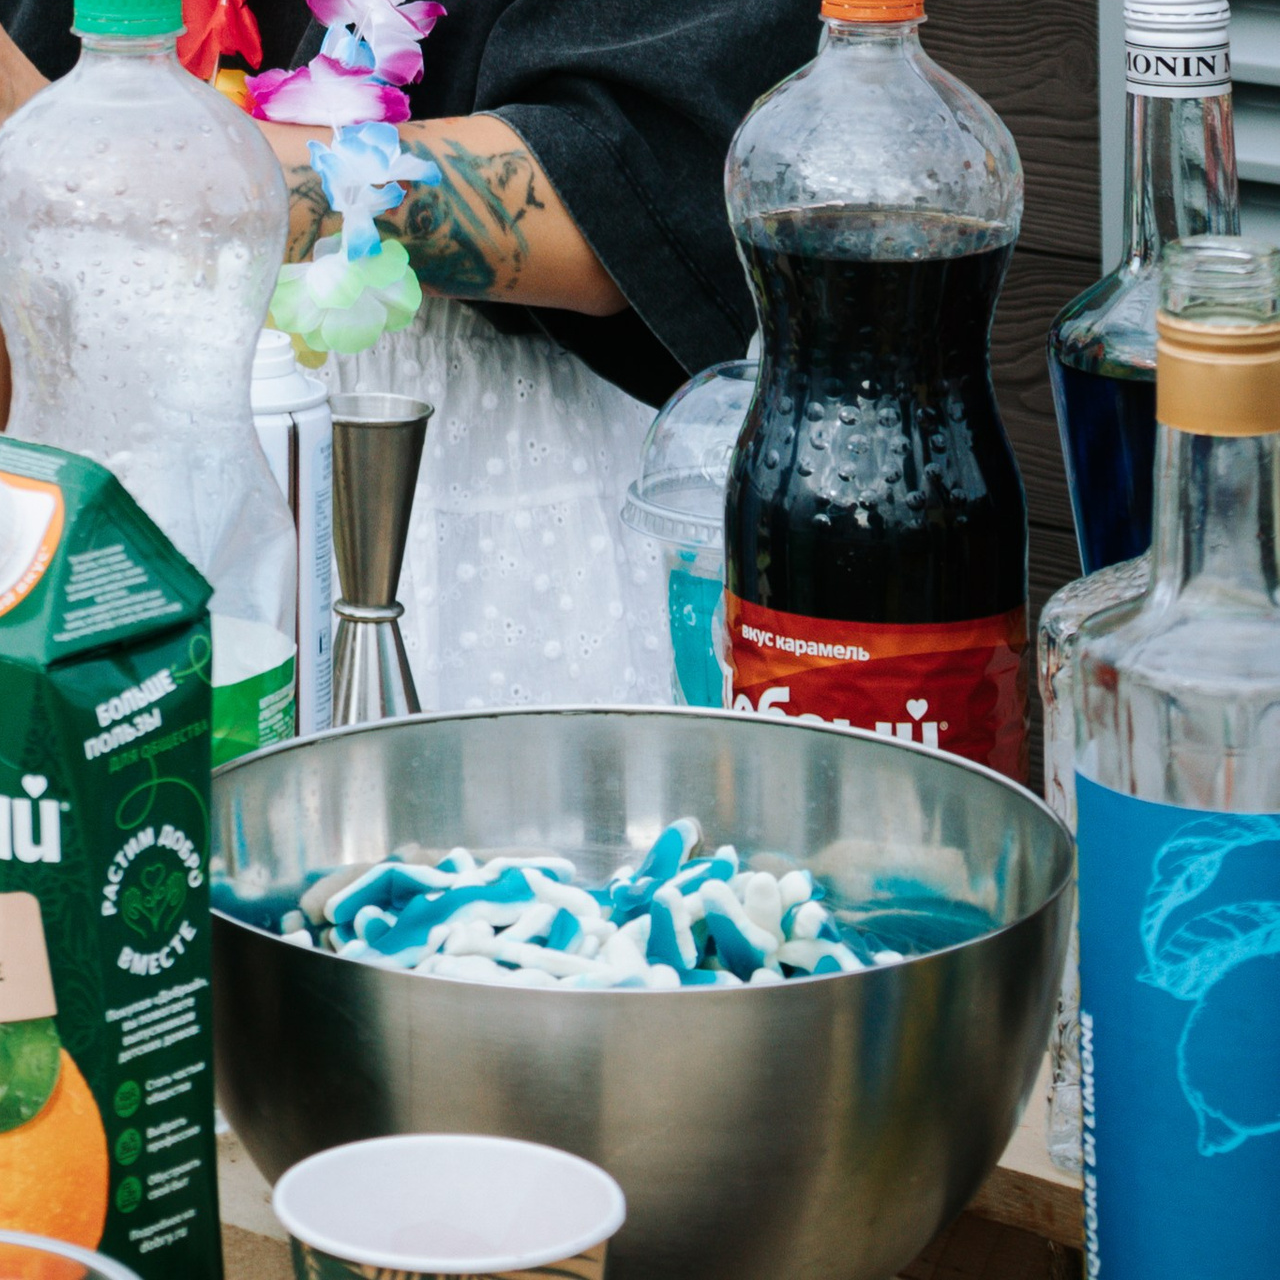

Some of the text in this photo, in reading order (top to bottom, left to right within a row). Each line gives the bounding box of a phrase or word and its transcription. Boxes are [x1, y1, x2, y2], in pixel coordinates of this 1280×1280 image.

[741, 623, 871, 662] вкус карамель
[94, 668, 178, 728] БОЛЬШЕ
[83, 706, 163, 761] ПОЛЬЗЫ
[100, 823, 204, 917] РАСТИМ ДОБРО
[116, 919, 198, 977] ВМЕСТЕ
[1080, 1007, 1097, 1130] LIMONE
